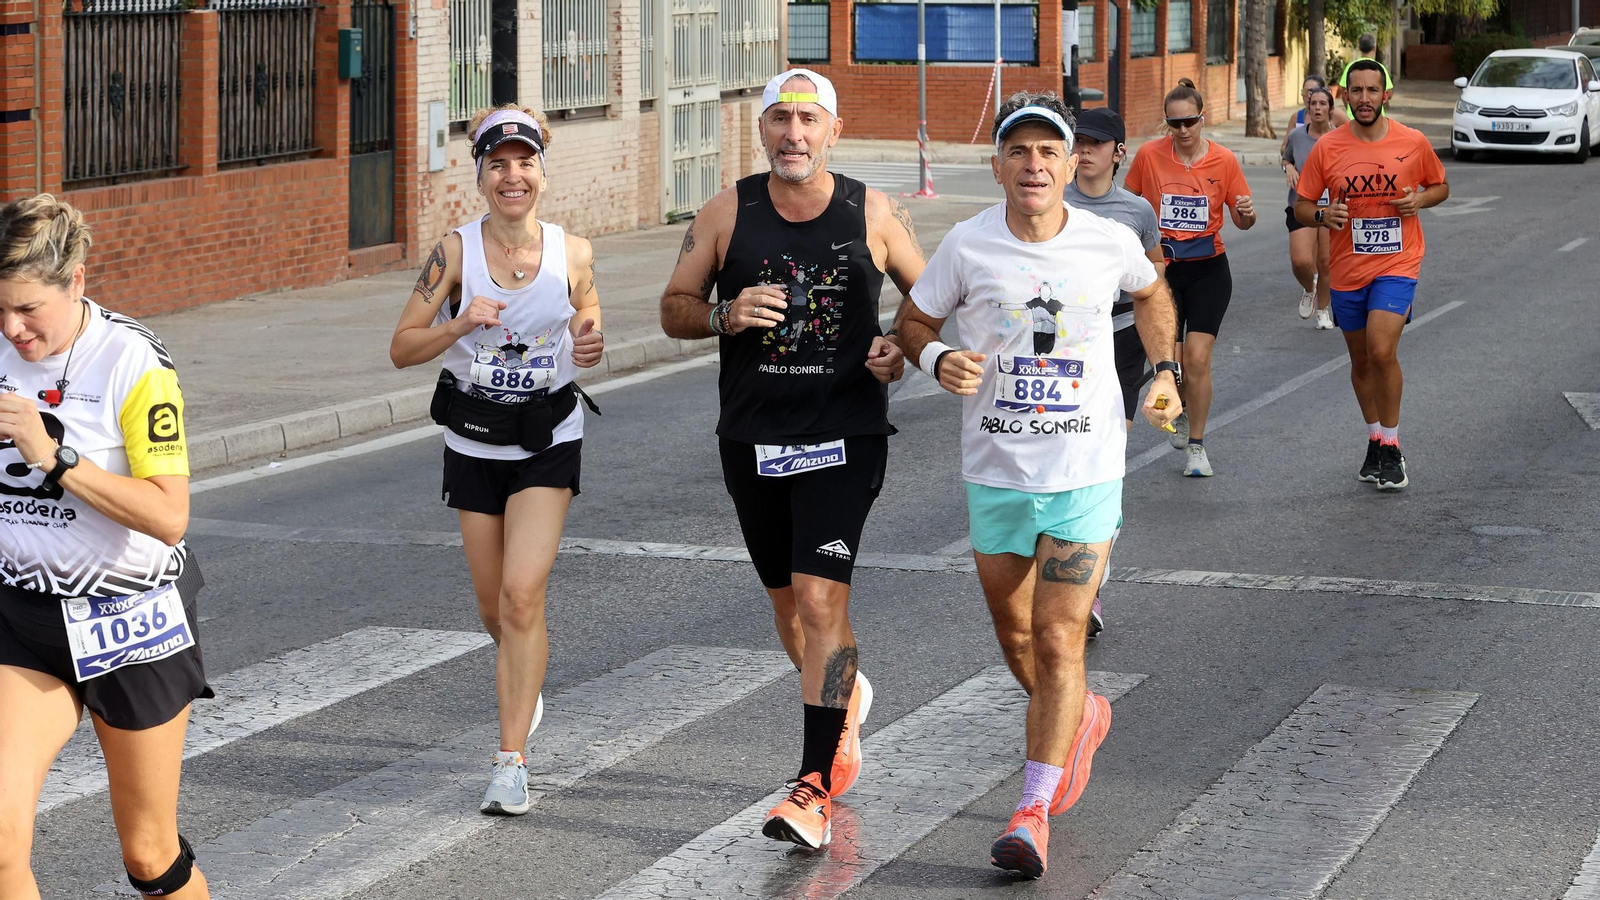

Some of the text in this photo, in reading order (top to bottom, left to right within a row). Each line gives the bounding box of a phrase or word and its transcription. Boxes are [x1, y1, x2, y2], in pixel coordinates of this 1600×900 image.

[1345, 174, 1397, 192] XXIX
[1172, 207, 1197, 219] 986
[1364, 230, 1389, 243] 978
[838, 254, 848, 292] NIKE
[758, 363, 824, 375] PABLO SONRIE
[491, 369, 535, 389] 886
[499, 393, 534, 403] Mizu
[1015, 379, 1062, 402] 884
[464, 422, 489, 433] KIPRUN
[979, 416, 1023, 434] PABLO
[90, 601, 168, 650] 1036
